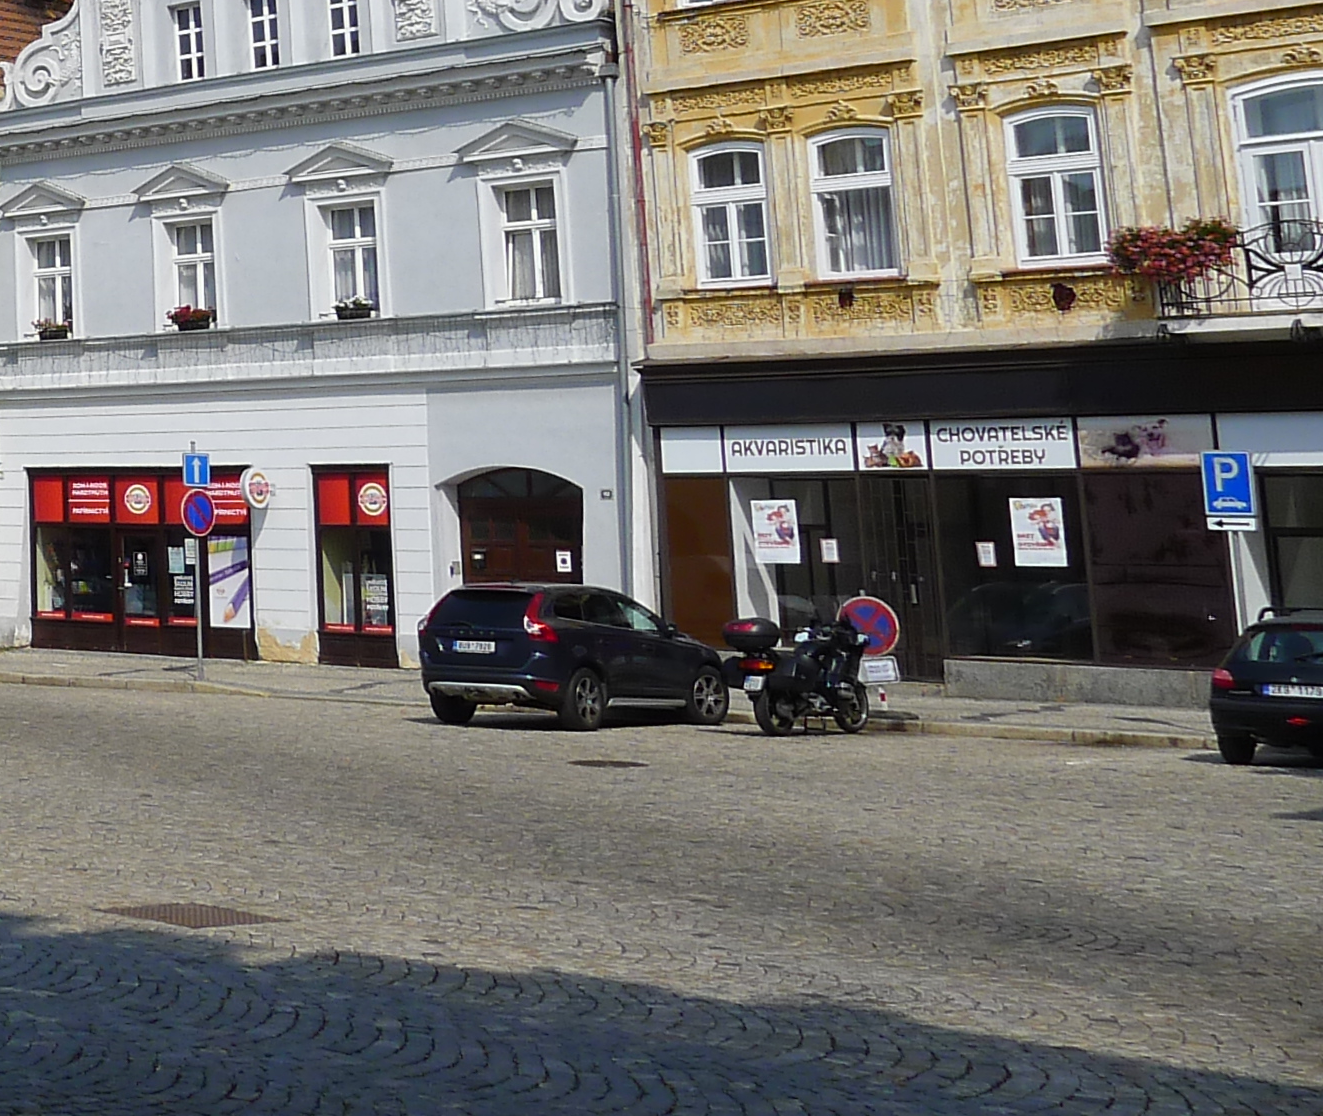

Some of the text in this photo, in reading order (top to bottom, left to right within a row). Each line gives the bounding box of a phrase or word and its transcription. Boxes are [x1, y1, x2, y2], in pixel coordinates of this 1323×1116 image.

[936, 420, 1068, 443] CHOVATELSKÉ
[731, 438, 847, 457] AKVARISTIKA
[960, 445, 1047, 465] POTŘEBY
[1212, 456, 1239, 492] P
